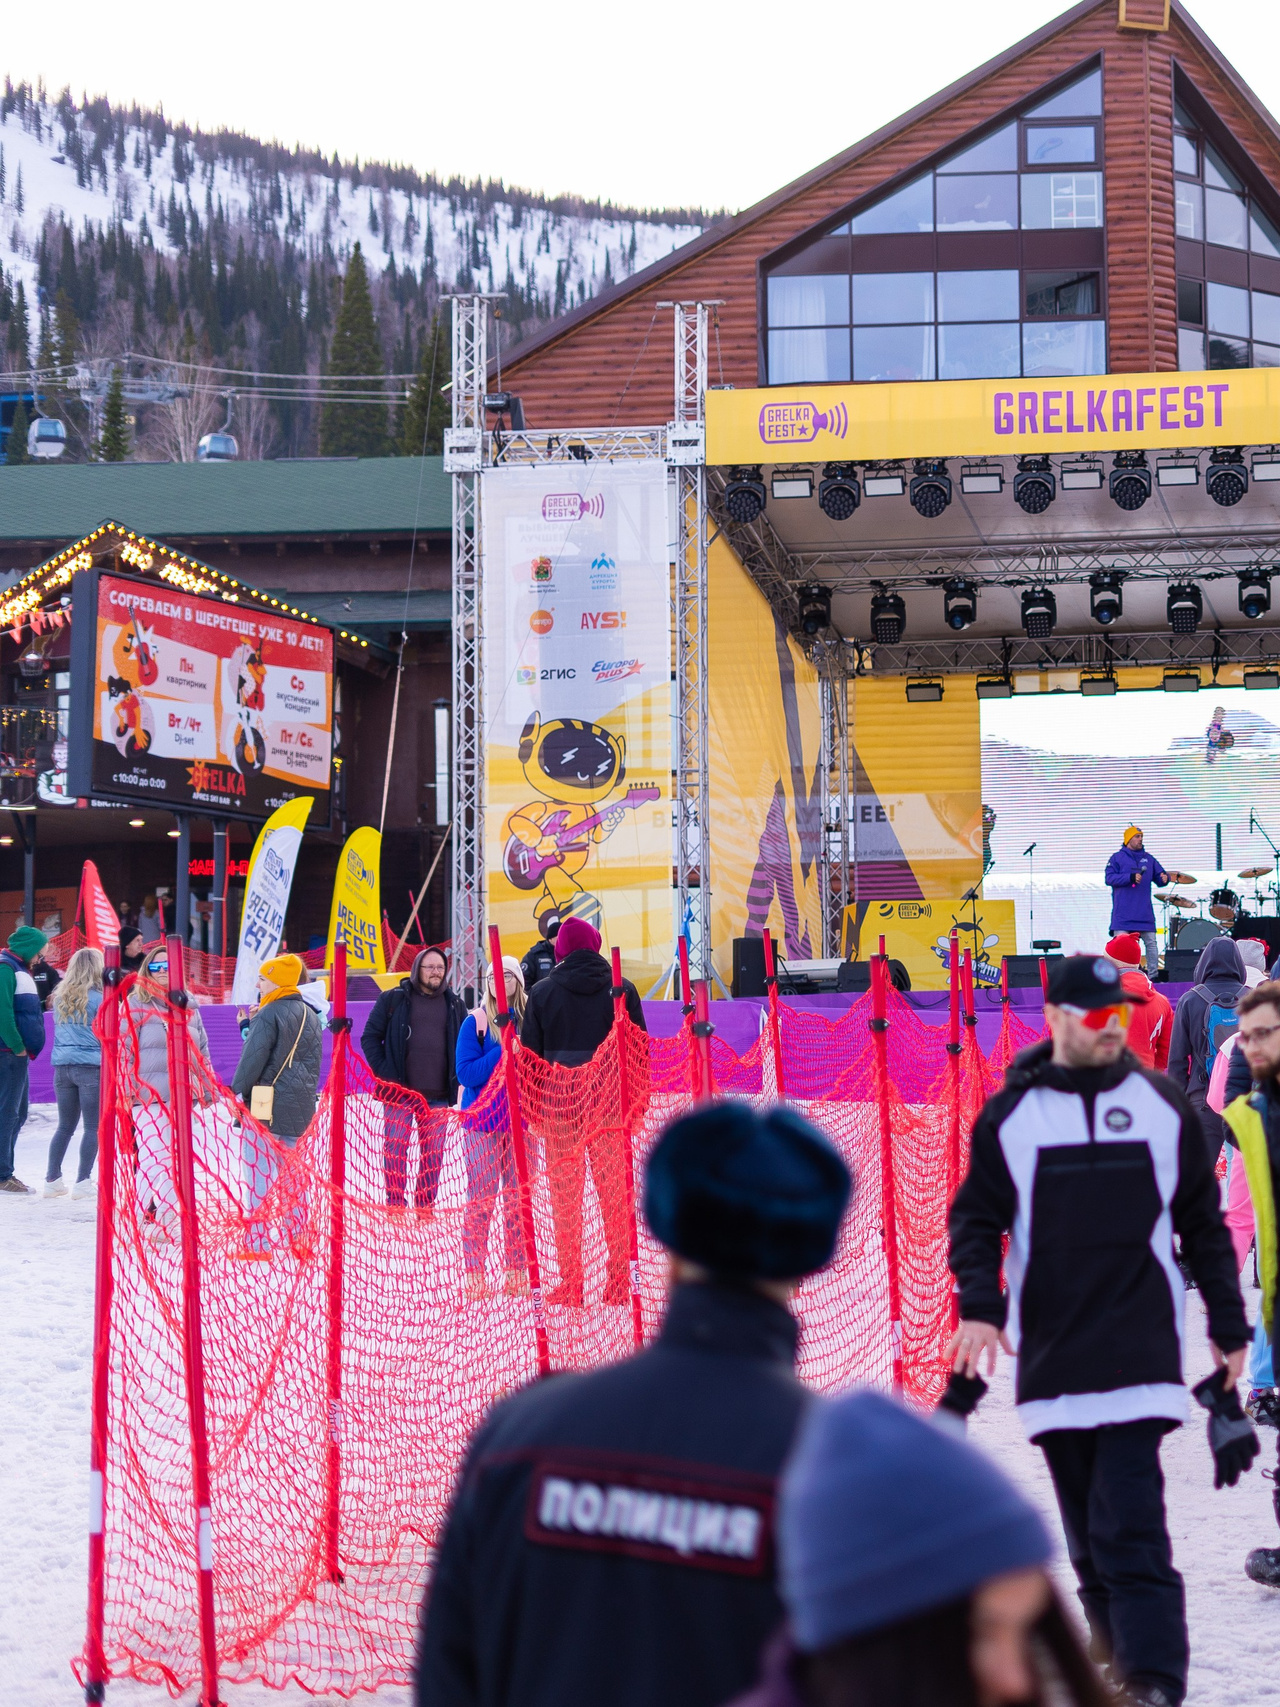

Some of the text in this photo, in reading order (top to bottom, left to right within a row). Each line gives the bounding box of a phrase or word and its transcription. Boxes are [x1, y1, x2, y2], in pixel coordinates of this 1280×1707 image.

[768, 408, 810, 422] GRELKA
[994, 384, 1229, 435] GRELKAFEST
[768, 424, 797, 438] FEST
[547, 498, 578, 508] GRELKA
[548, 508, 568, 517] FEST
[109, 590, 324, 652] СОГРЕВАЕМ В ШЕРЕГЕШЕ УЖЕ 10 ЛЕТ!
[581, 611, 627, 629] AYS!
[591, 659, 635, 672] Europa
[540, 668, 577, 680] 2ГИС
[166, 675, 207, 690] квартирник
[276, 692, 320, 707] акустический
[284, 702, 311, 714] концерт
[174, 733, 194, 745] Dj-set
[271, 747, 288, 756] днем
[295, 751, 323, 762] вечером
[286, 756, 308, 768] Dj-sets
[118, 773, 139, 785] 10:00
[138, 777, 149, 787] до
[149, 777, 167, 789] 0:00
[191, 766, 246, 797] GRELKA
[218, 796, 231, 804] BAR
[537, 1474, 761, 1560] ПОЛИЦИЯ
